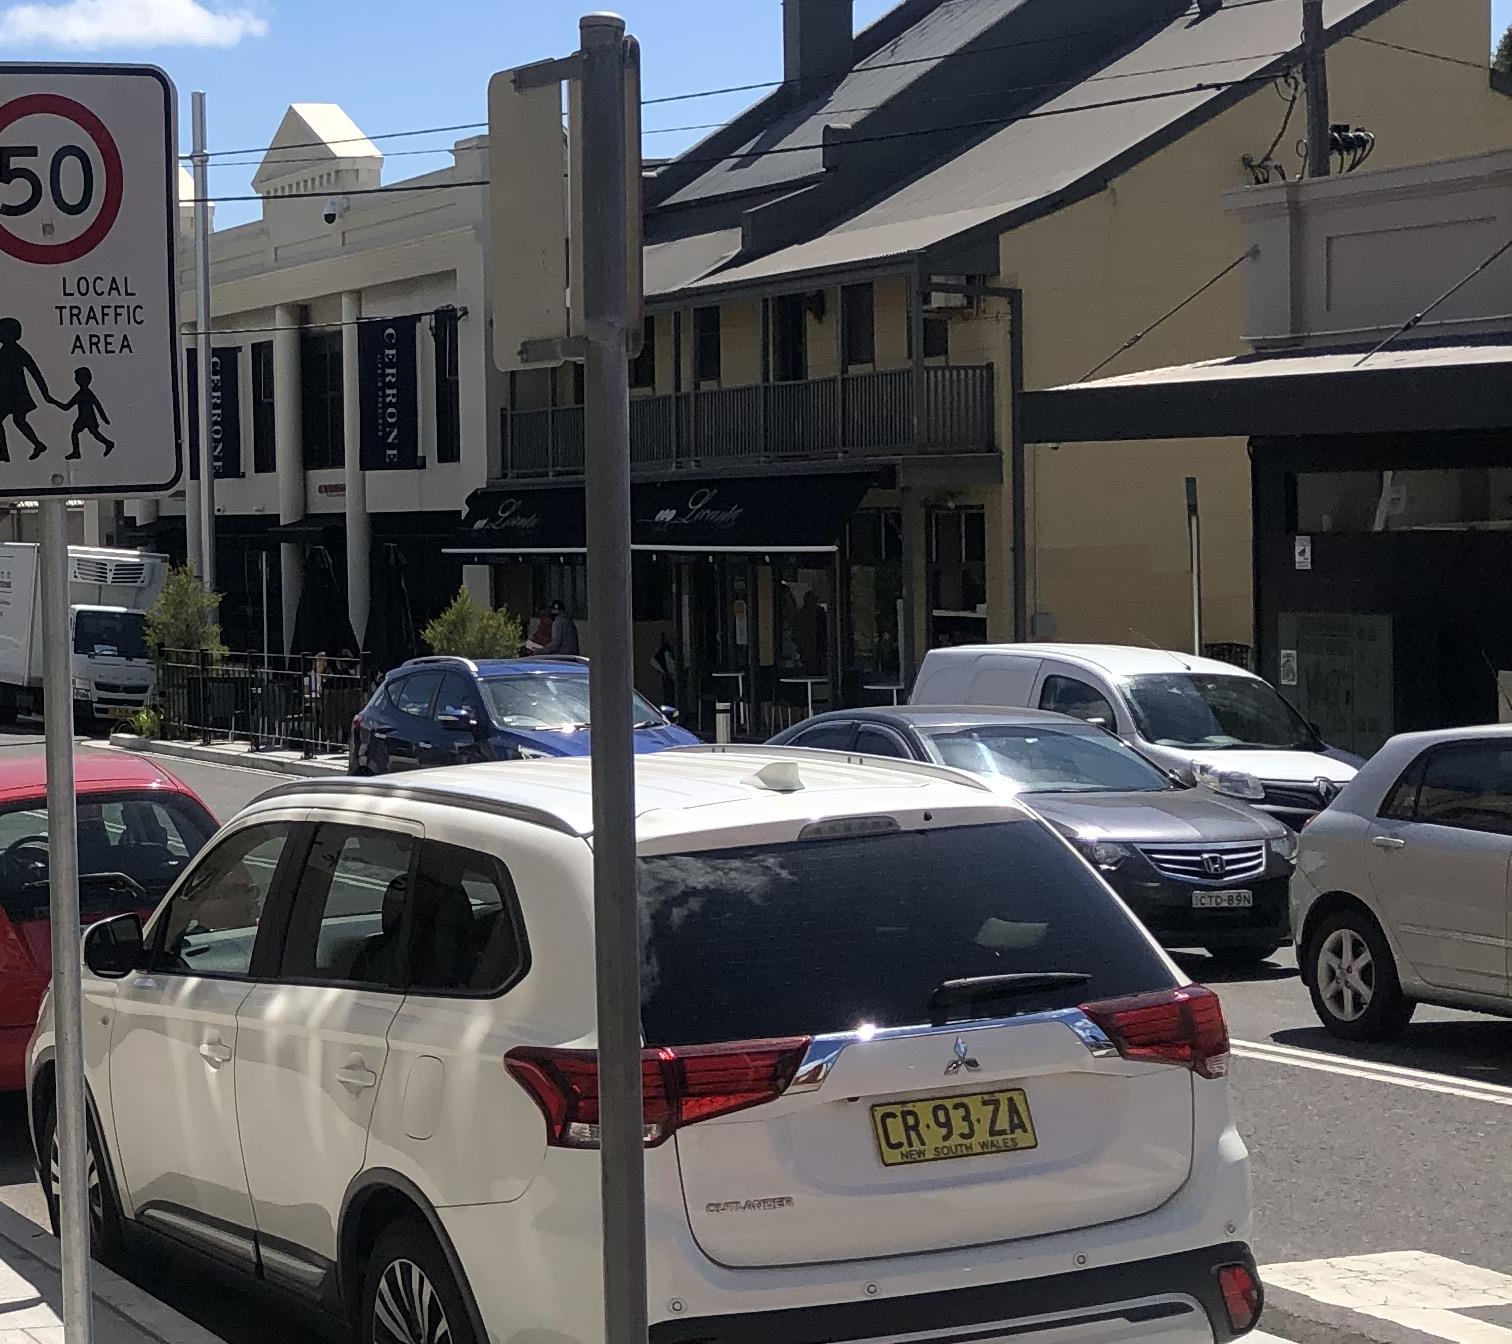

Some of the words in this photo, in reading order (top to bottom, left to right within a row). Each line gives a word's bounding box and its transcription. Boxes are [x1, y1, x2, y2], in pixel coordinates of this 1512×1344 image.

[62, 276, 137, 297] LOCAL
[54, 304, 145, 326] TRAFFIC
[70, 333, 134, 355] AREA
[383, 327, 399, 464] CERRONE
[210, 356, 224, 474] CERRONE
[899, 1149, 927, 1161] NEW
[933, 1142, 974, 1157] SOUTH
[978, 1137, 1019, 1151] WALES
